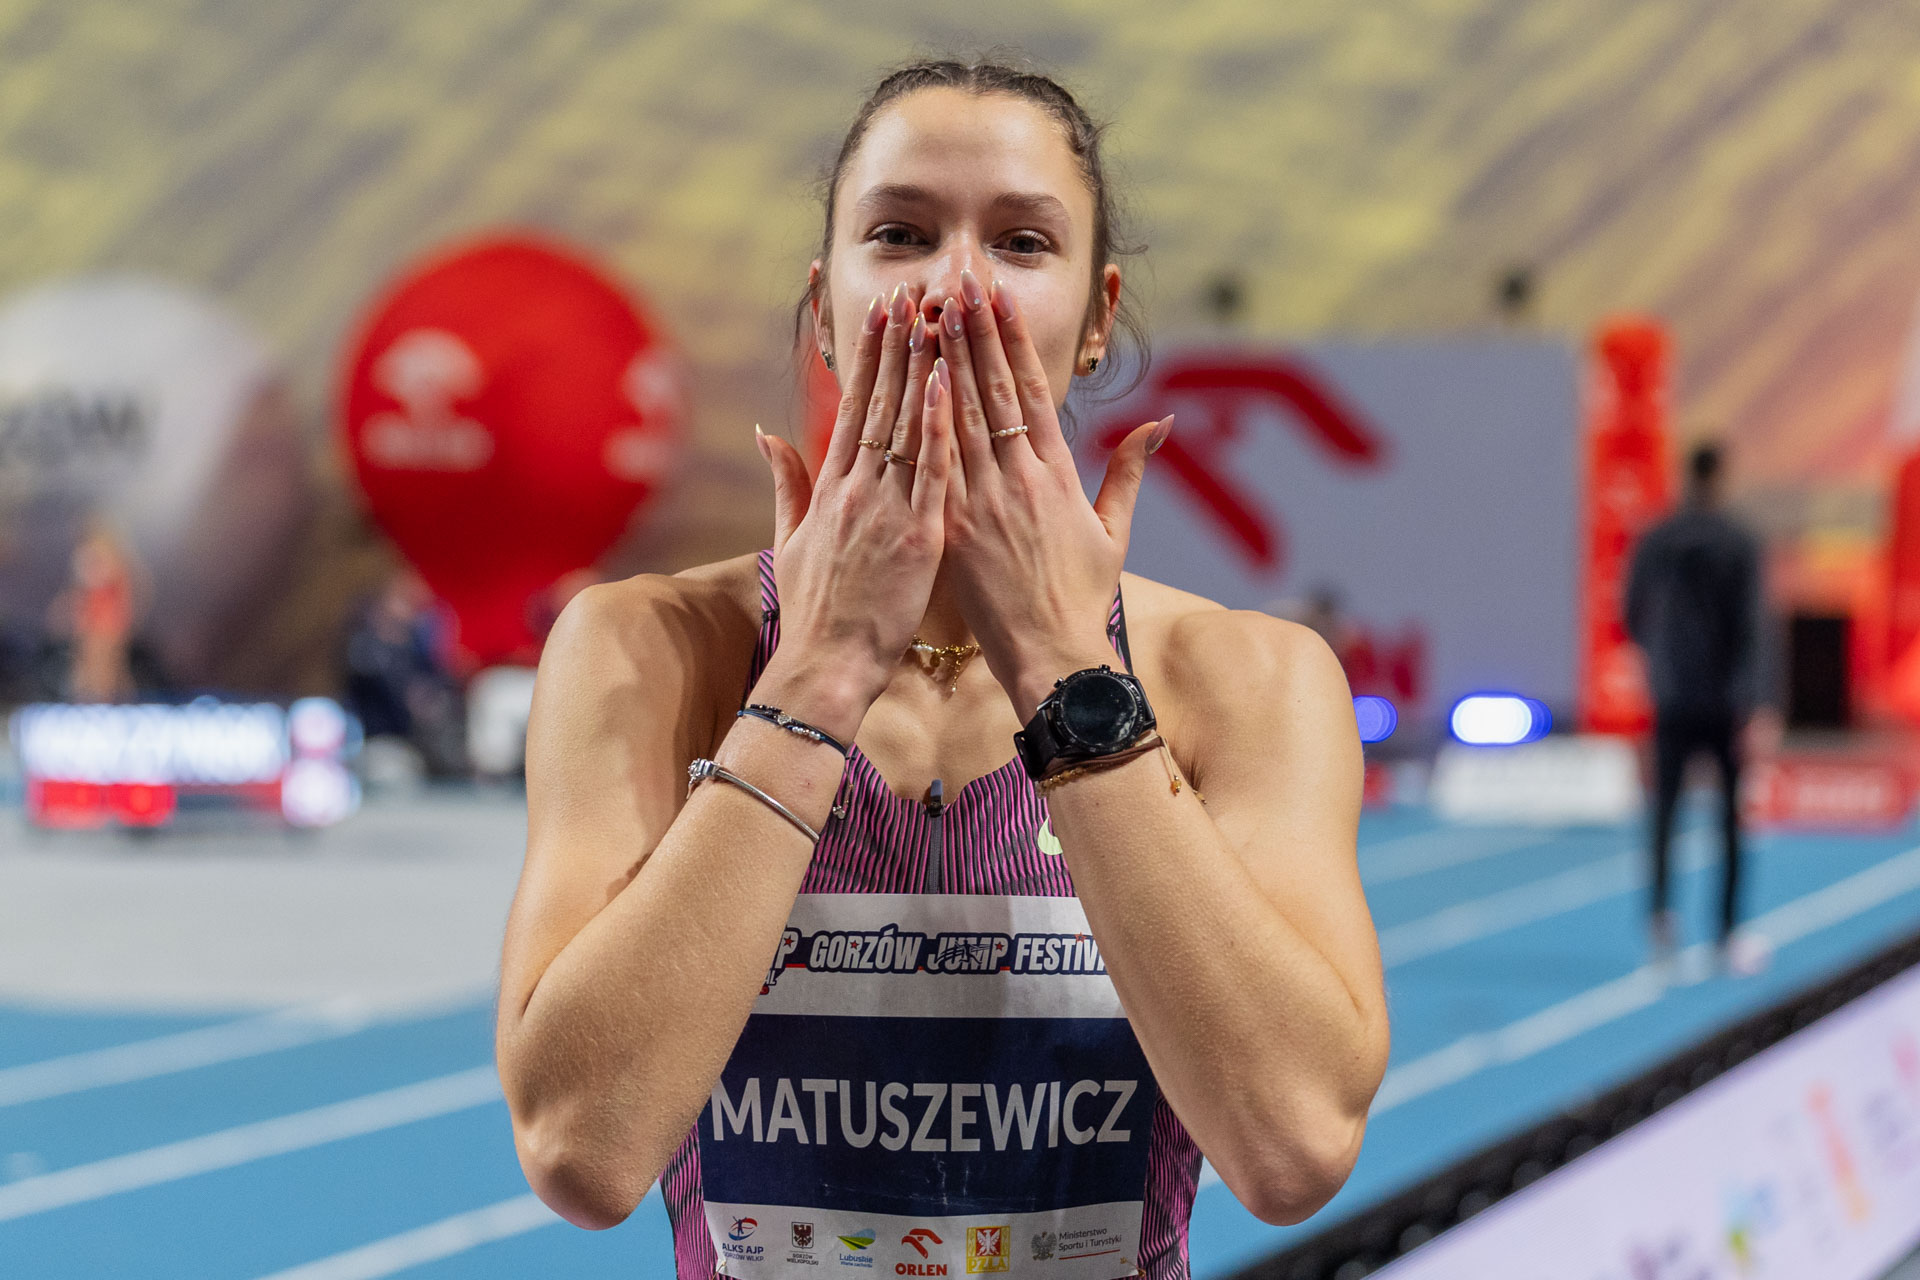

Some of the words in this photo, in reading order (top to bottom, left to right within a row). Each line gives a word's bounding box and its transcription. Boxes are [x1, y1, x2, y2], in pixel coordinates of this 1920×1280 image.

[809, 926, 923, 971] GORZÓW
[926, 935, 1010, 971] JUMP
[710, 1076, 1138, 1153] MATUSZEWICZ
[1058, 1227, 1108, 1241] Ministerstwo
[722, 1242, 744, 1254] ALKS
[745, 1245, 764, 1255] AJP
[1058, 1240, 1084, 1253] Sportu
[1090, 1234, 1122, 1248] Turystyki
[839, 1252, 873, 1263] Lubuskie
[970, 1256, 1008, 1273] PZLA
[894, 1262, 948, 1276] ORLEN
